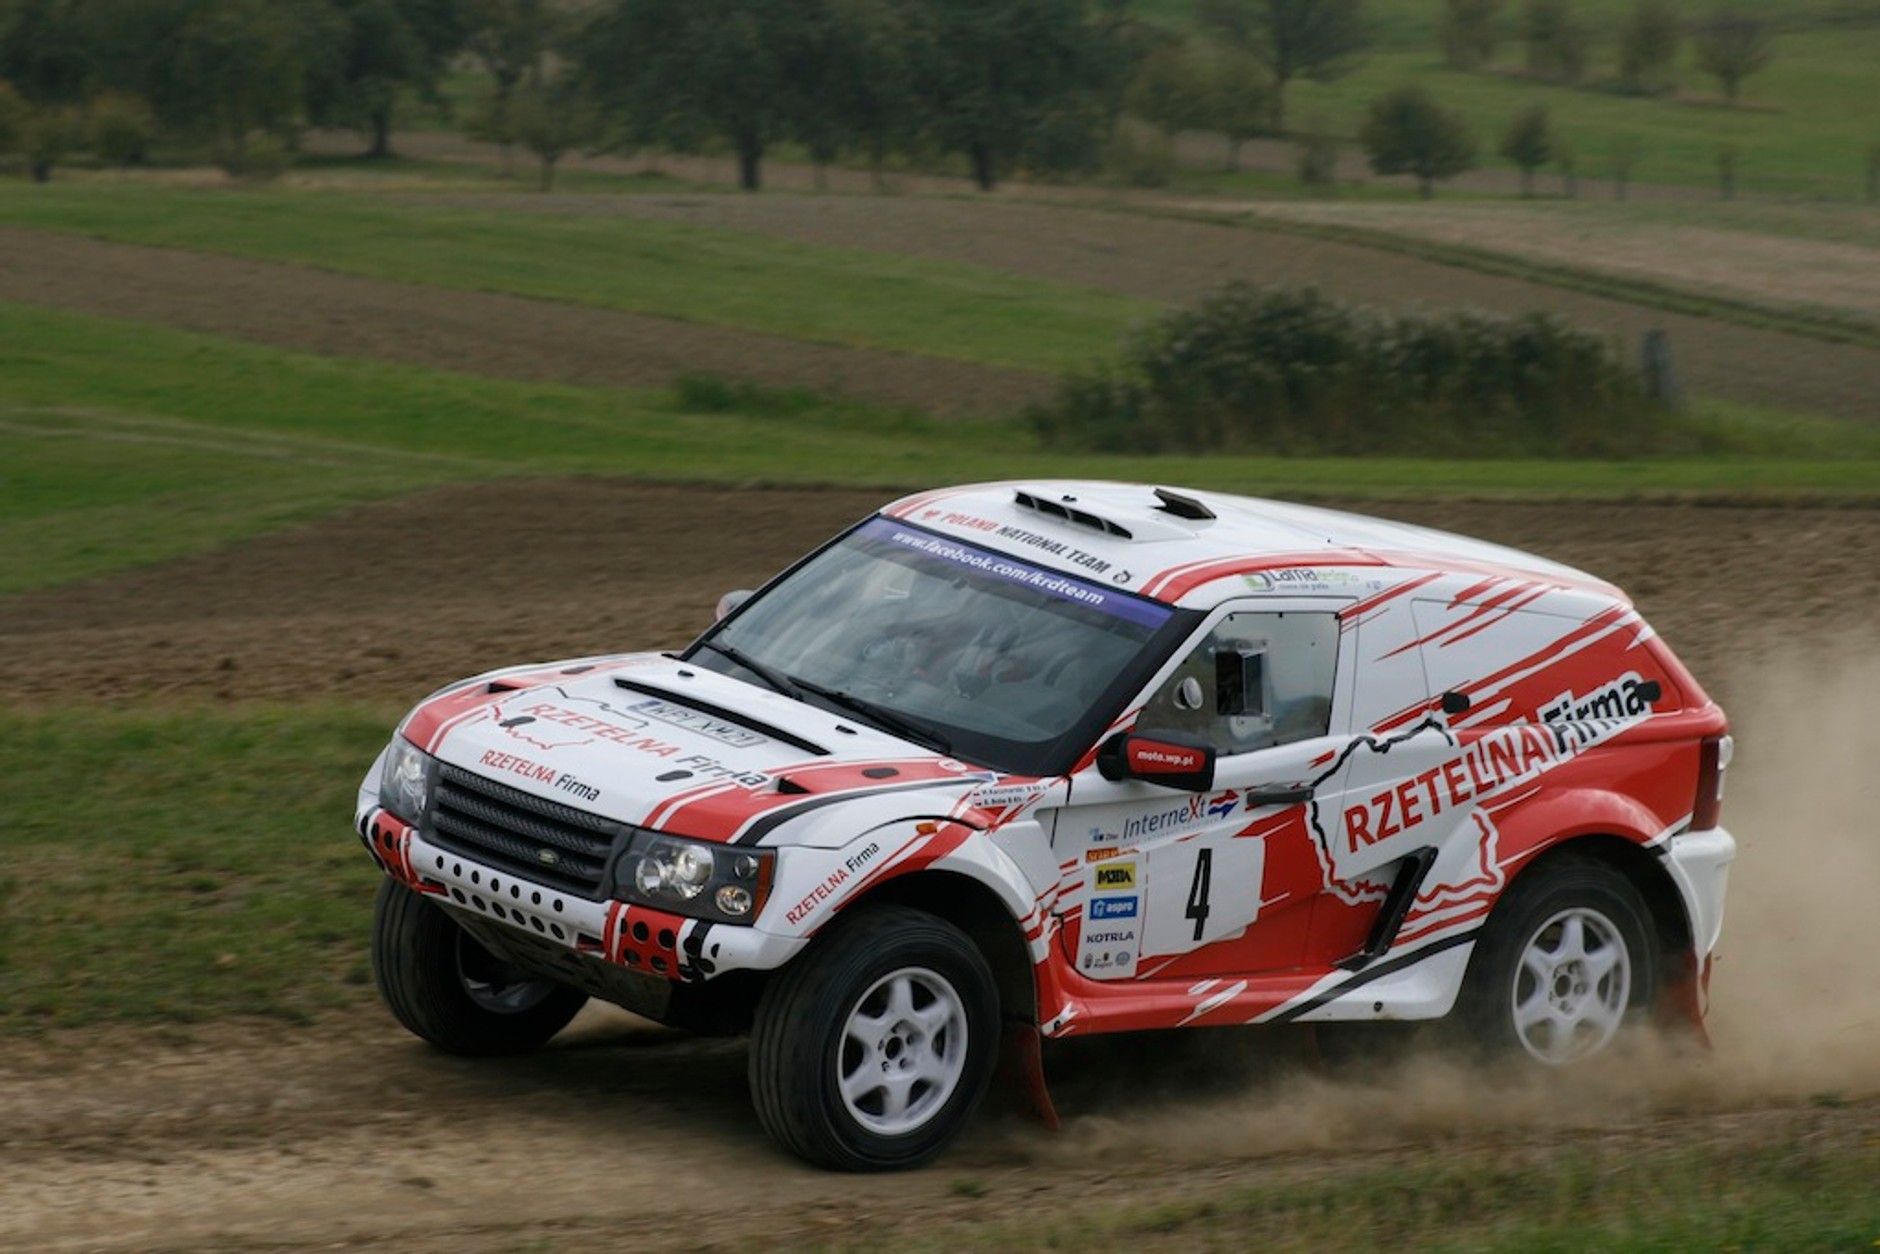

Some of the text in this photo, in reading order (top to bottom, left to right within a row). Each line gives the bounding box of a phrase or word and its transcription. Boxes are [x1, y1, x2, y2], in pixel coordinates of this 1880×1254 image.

[892, 532, 1105, 605] www.facebook.com/krdteam
[939, 512, 1112, 575] POLAND NATIONAL TEAM
[521, 704, 681, 757] RZETELNA
[1137, 751, 1194, 766] moto.wp.pl
[479, 749, 600, 802] RZETELNA Firma
[1344, 679, 1646, 853] RZETELNA Firma
[786, 842, 880, 925] RZETELNA Firma
[1106, 901, 1133, 914] aspro
[1185, 848, 1213, 942] 4
[1086, 930, 1134, 943] KOTRLA
